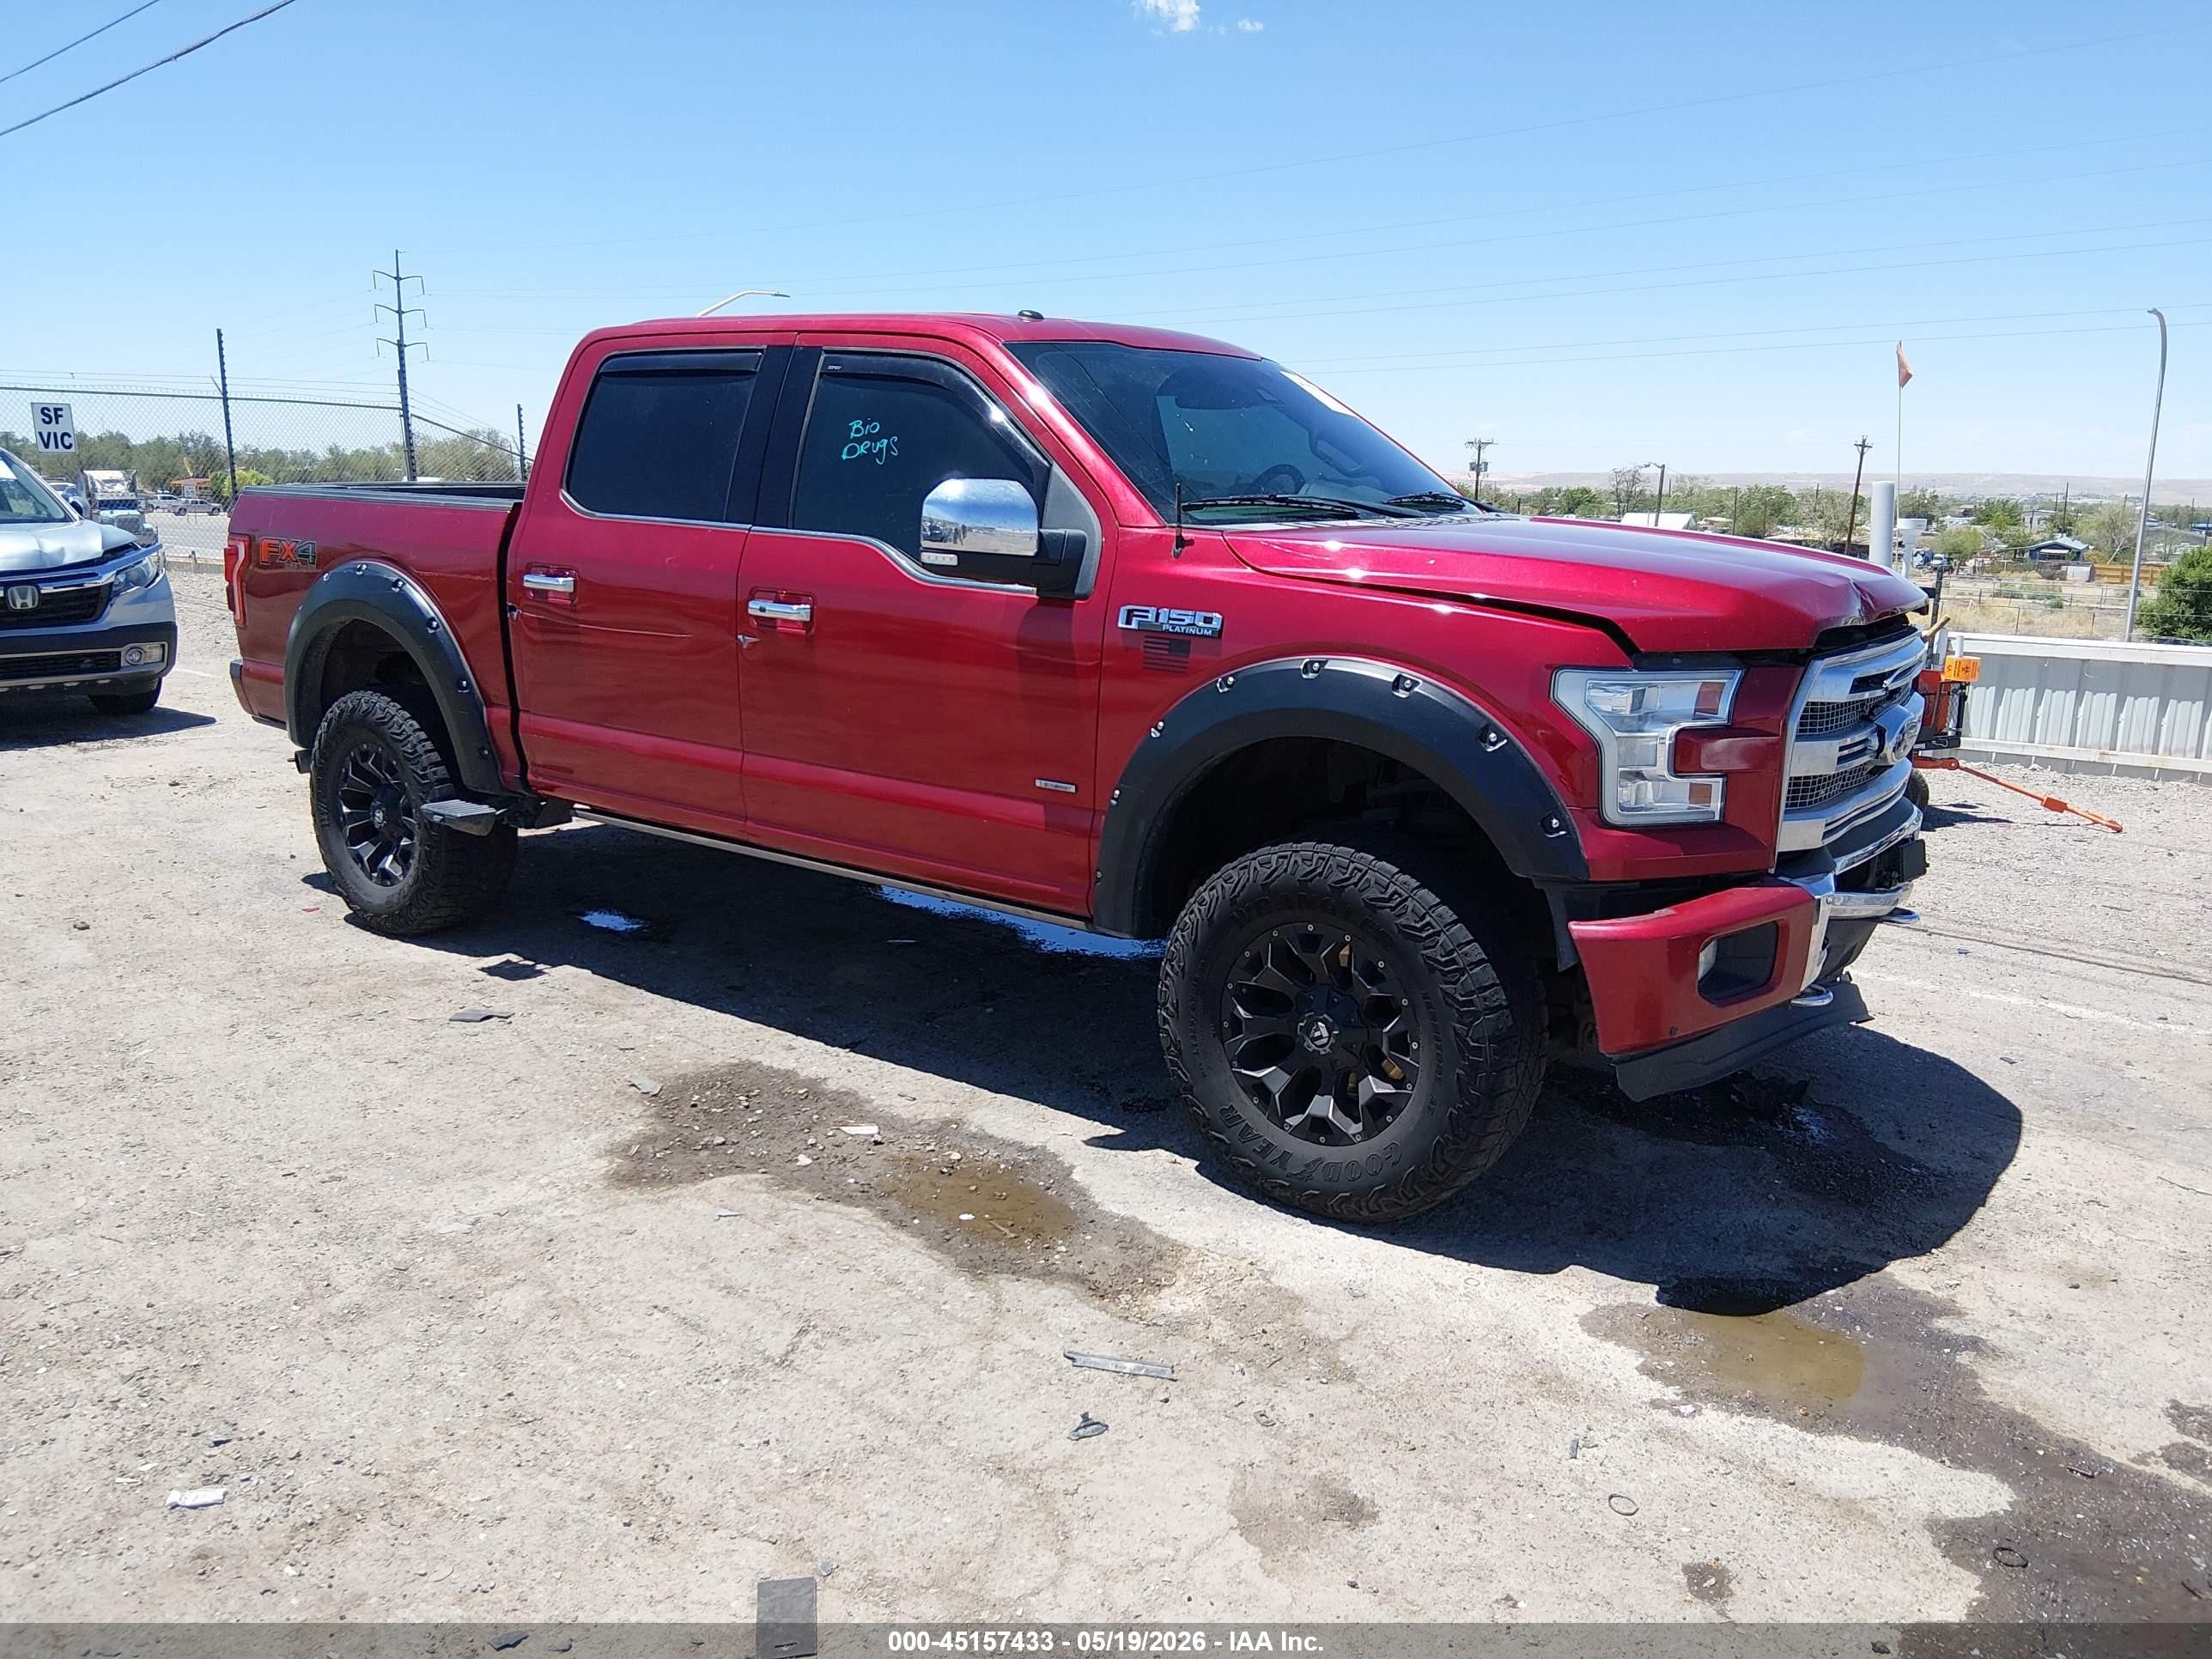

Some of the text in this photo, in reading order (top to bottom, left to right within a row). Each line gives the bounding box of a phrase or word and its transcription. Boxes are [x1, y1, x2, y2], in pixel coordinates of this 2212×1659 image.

[40, 406, 64, 425] SF
[38, 431, 73, 450] VIC
[260, 536, 317, 567] FX4
[1162, 624, 1212, 636] PLATINUM
[1219, 1104, 1401, 1182] GOODYEAR
